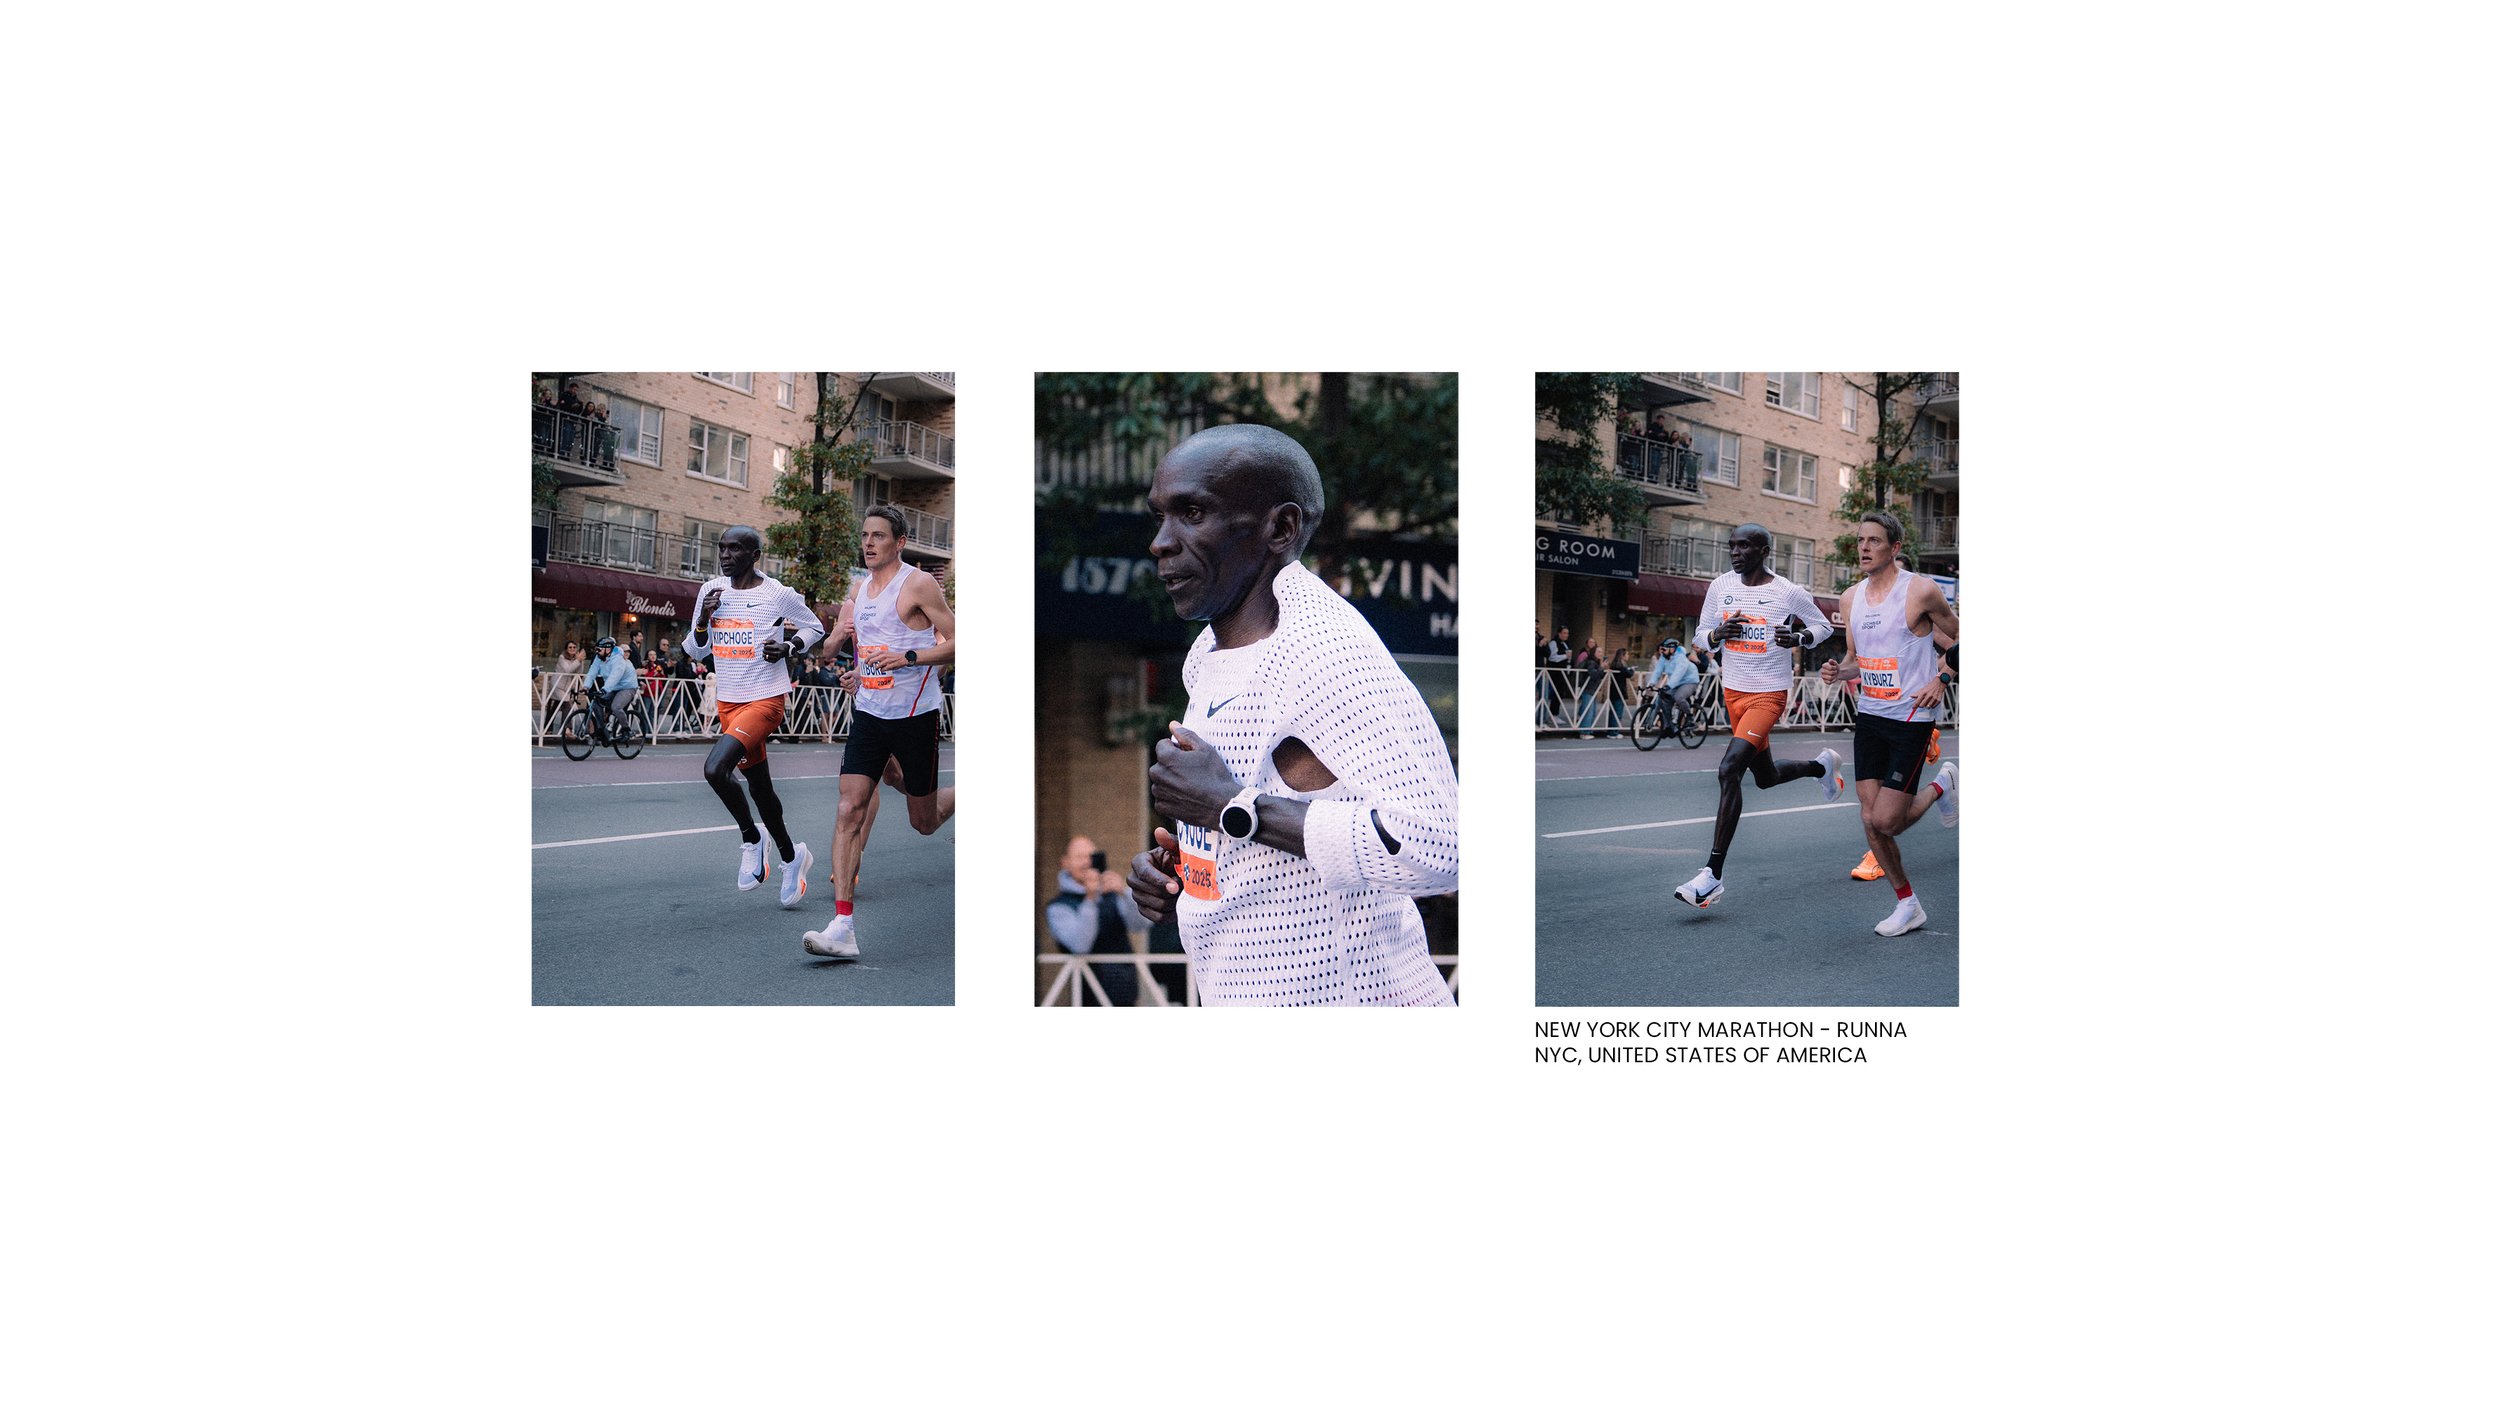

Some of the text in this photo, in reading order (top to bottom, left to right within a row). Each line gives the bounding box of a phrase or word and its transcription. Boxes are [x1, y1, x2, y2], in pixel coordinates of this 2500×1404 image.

[1560, 540, 1615, 559] ROOM
[1548, 554, 1579, 565] SALON
[628, 596, 676, 616] Blondis
[713, 631, 752, 645] KIPCHOGE
[1863, 672, 1894, 687] KYBURZ
[1191, 868, 1211, 888] 2025
